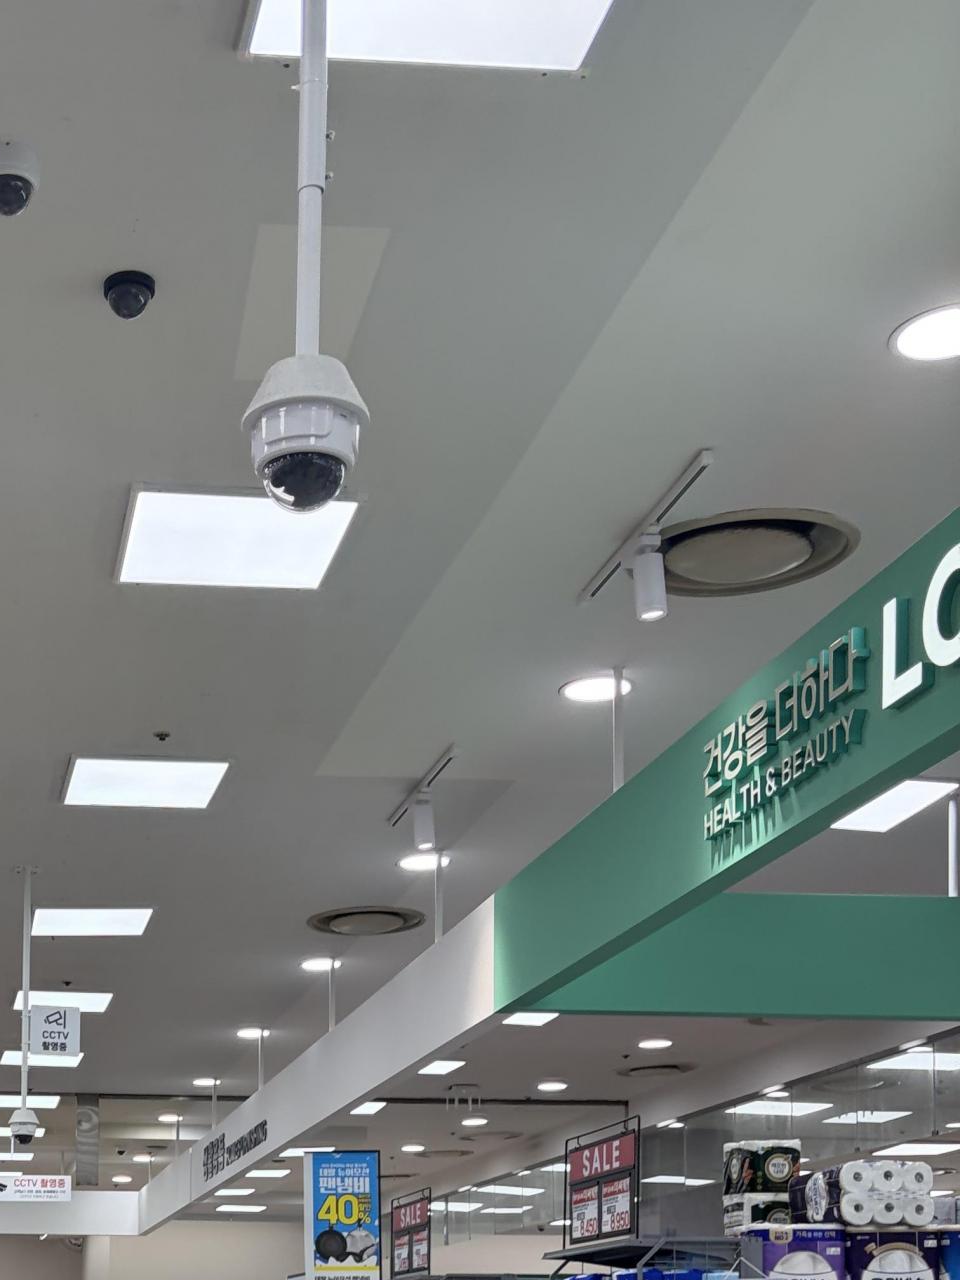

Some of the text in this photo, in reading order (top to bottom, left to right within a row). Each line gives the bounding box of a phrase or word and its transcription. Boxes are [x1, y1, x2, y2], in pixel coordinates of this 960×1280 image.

[703, 628, 866, 797] 건강을 더하다
[703, 709, 858, 840] HEALTH & BEAUTY
[41, 1041, 68, 1052] 촬영중
[42, 1030, 69, 1040] CCTV
[582, 1139, 620, 1177] SALE
[14, 1178, 38, 1188] CCTV
[319, 1177, 370, 1194] 팬냄비
[317, 1193, 360, 1225] 40
[400, 1203, 421, 1228] SALE
